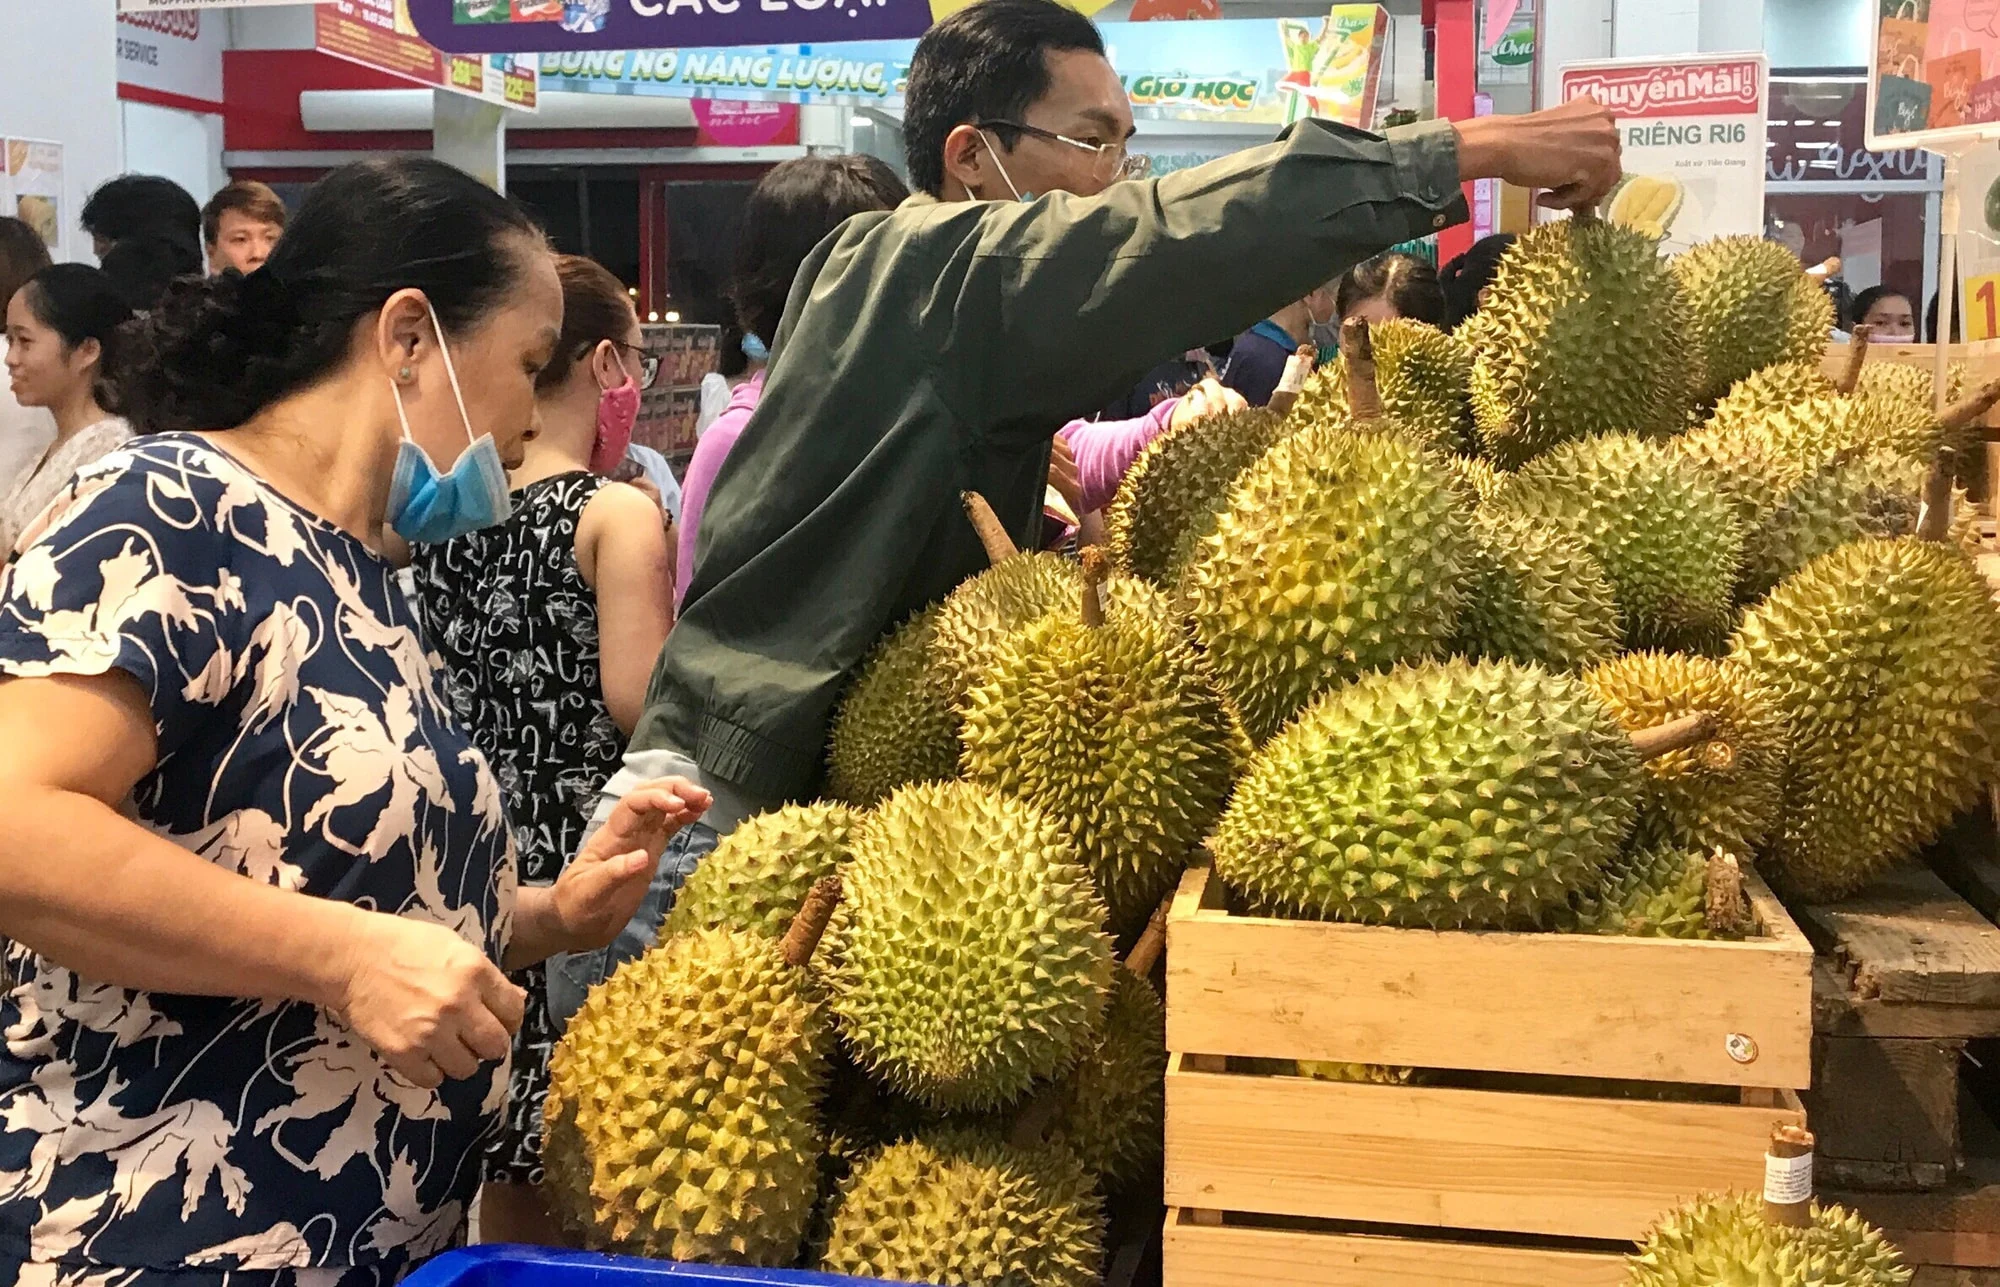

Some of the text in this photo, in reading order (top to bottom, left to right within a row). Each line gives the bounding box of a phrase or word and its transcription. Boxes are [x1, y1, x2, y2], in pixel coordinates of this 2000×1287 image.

[681, 49, 773, 87] NĂNG
[1628, 121, 1702, 147] RIÊNG
[1709, 123, 1747, 145] RI6
